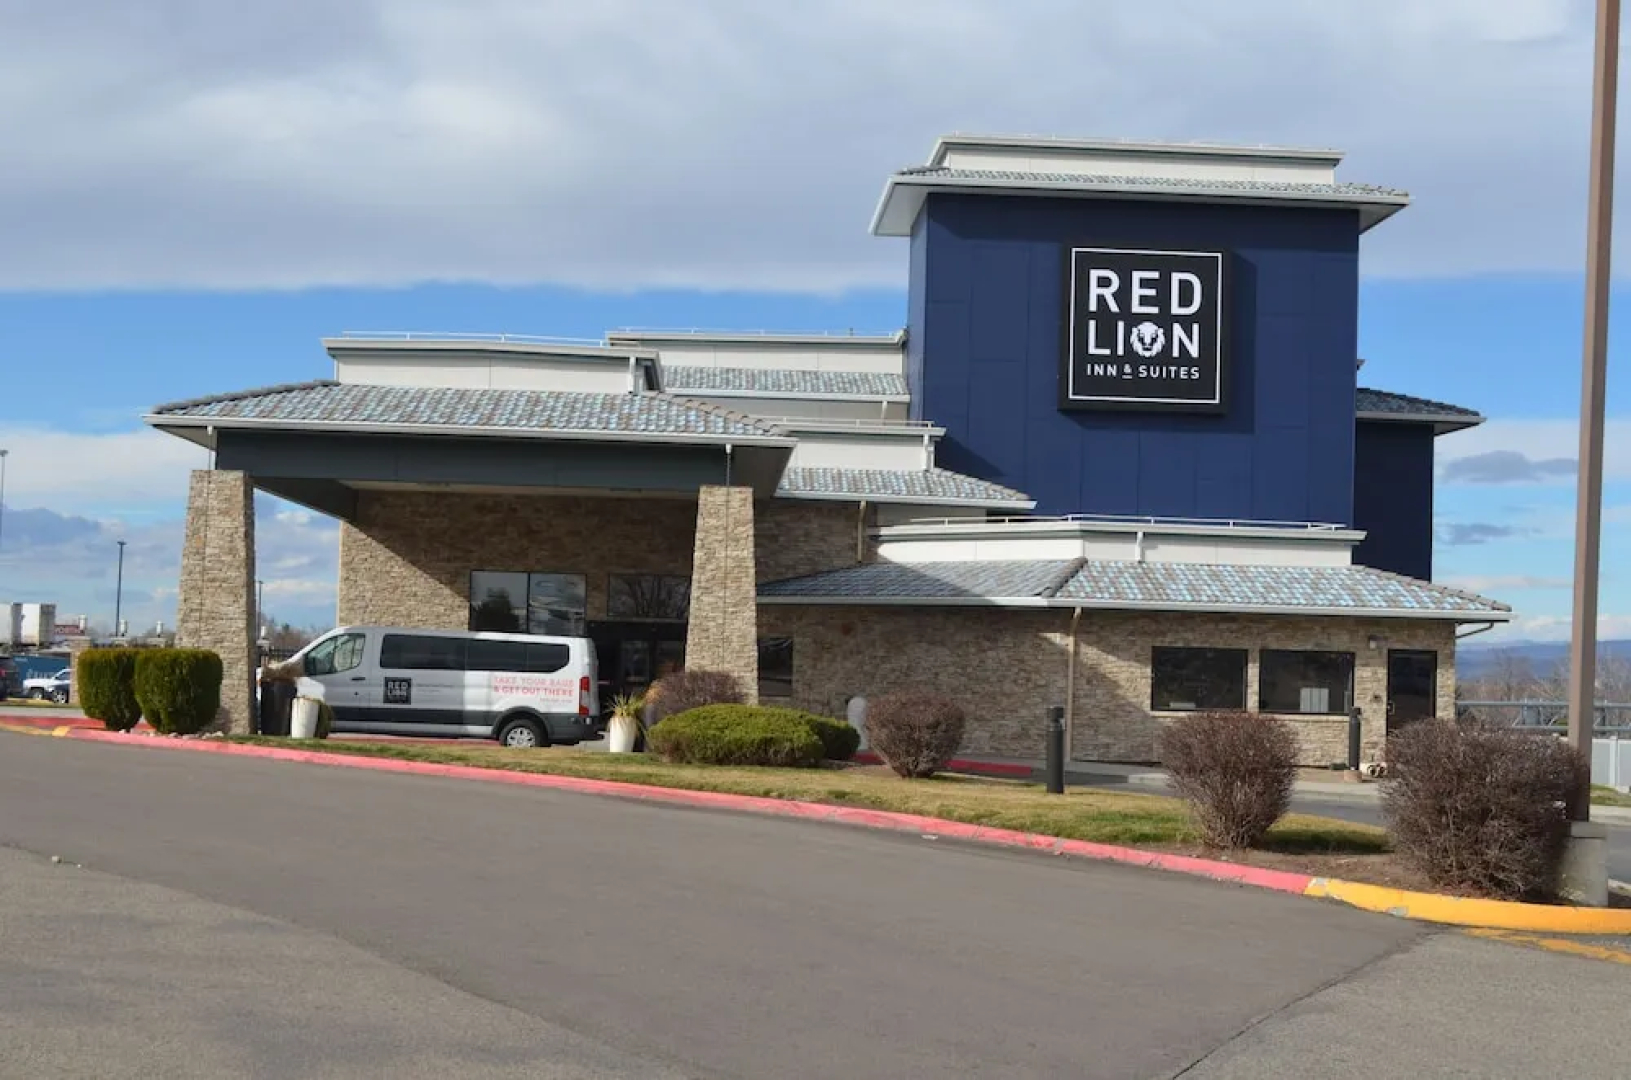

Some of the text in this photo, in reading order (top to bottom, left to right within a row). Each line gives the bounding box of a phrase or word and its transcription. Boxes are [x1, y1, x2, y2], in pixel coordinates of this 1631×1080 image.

[1088, 268, 1203, 316] RED
[1087, 319, 1200, 358] LION
[1087, 363, 1200, 379] INN & SUITES
[388, 681, 408, 689] RED
[521, 678, 546, 687] YOUR
[501, 685, 520, 694] GET
[521, 687, 541, 695] OUT
[543, 688, 574, 697] THERE
